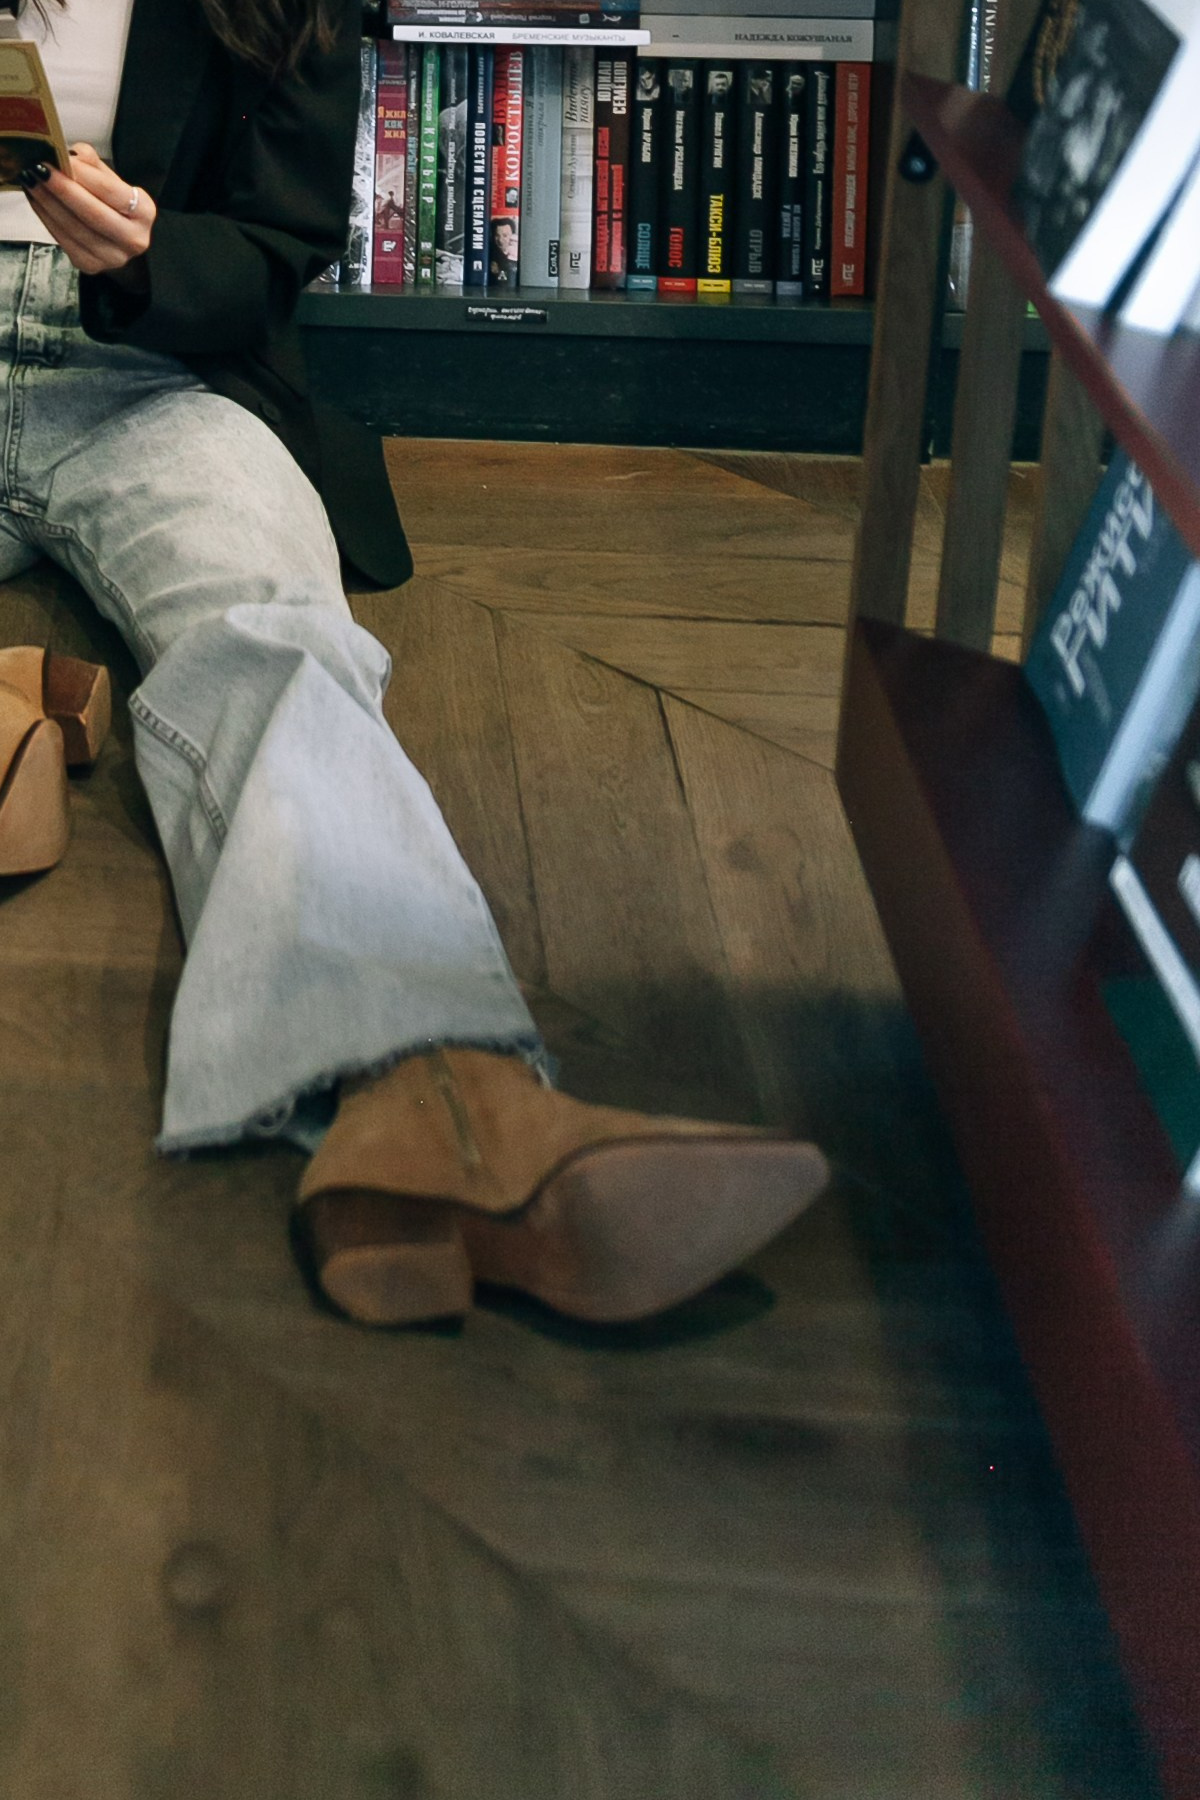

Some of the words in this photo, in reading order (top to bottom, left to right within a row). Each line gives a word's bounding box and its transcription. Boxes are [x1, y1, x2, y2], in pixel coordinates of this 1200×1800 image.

[597, 61, 611, 102] ЮЛИАН
[613, 61, 627, 114] СЕМЕНОВ
[505, 52, 522, 181] КОРОСТЫЛЕВ
[422, 127, 436, 204] КУРЬЕР
[446, 142, 456, 184] Токарева
[474, 122, 486, 172] ПОВЕСТИ
[444, 187, 455, 231] Виктория
[472, 188, 484, 250] СЦЕНАРИИ
[637, 223, 651, 269] СОЛНЦЕ
[668, 227, 683, 267] ГОЛОС
[707, 194, 724, 273] ТАКСИ-БЛЮЗ
[748, 229, 763, 273] ОТРЫВ
